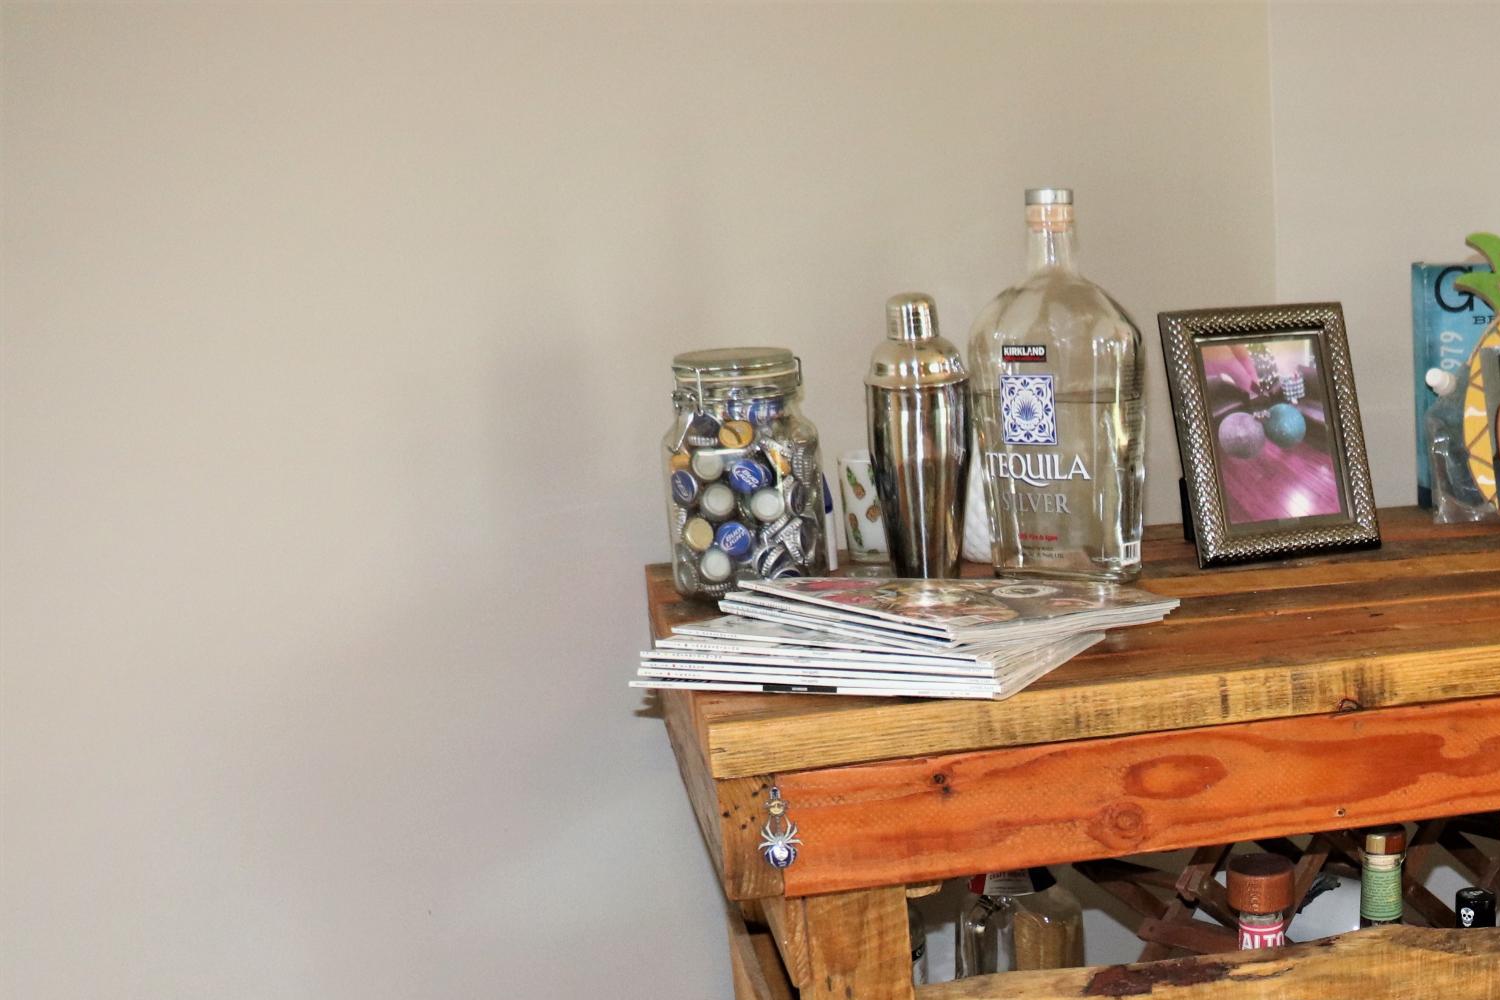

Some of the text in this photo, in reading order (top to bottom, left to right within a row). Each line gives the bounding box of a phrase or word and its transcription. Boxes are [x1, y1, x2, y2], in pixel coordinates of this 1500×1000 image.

[1003, 346, 1046, 356] KIRKLAND
[985, 452, 1092, 487] TEQUILA
[1001, 493, 1071, 514] SILVER
